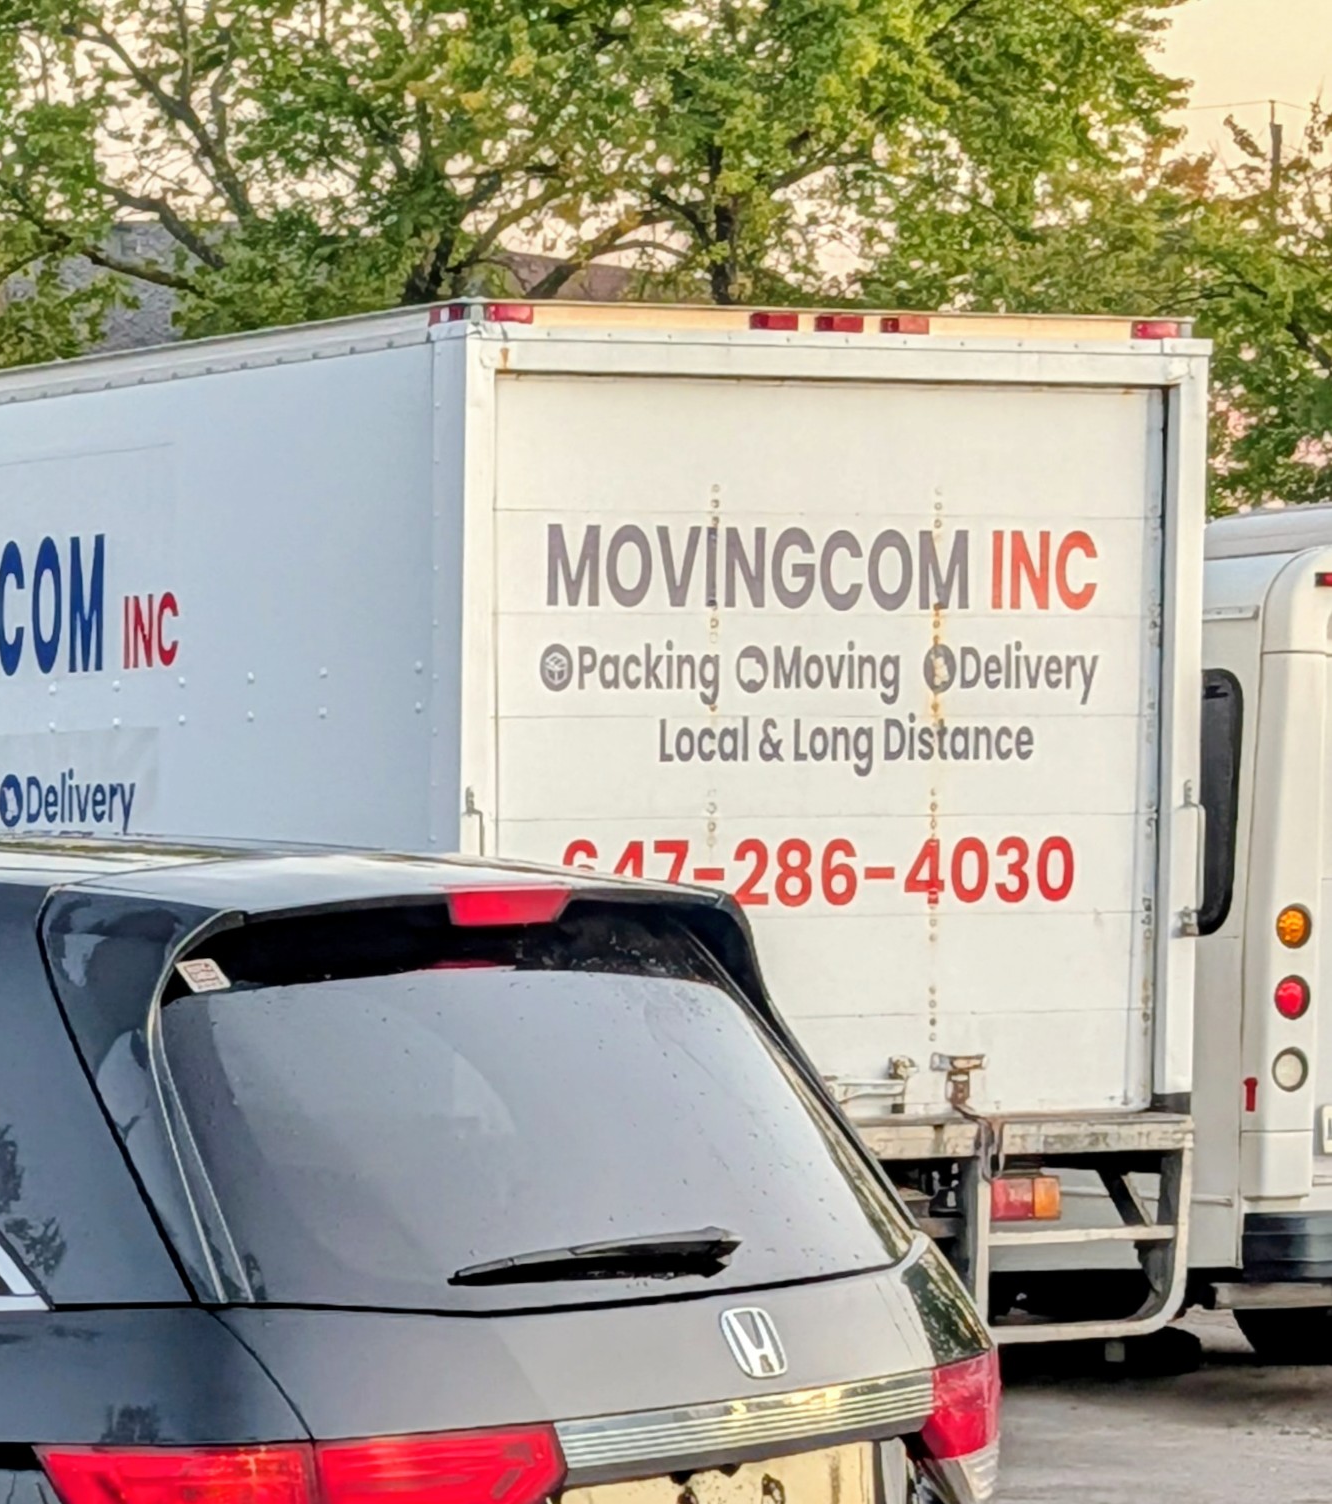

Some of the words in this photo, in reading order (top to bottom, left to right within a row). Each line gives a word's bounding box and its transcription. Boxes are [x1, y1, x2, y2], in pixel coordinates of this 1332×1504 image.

[546, 524, 970, 611] MOVINGCOM
[990, 530, 1098, 610] INC
[123, 592, 179, 670] INC
[577, 640, 721, 704] Packing
[772, 641, 901, 704] Moving
[959, 642, 1099, 704] Delivery
[658, 717, 749, 763] Local
[758, 719, 784, 763] &
[793, 720, 874, 777] Long
[883, 715, 1034, 761] Distance
[25, 768, 135, 834] Delivery
